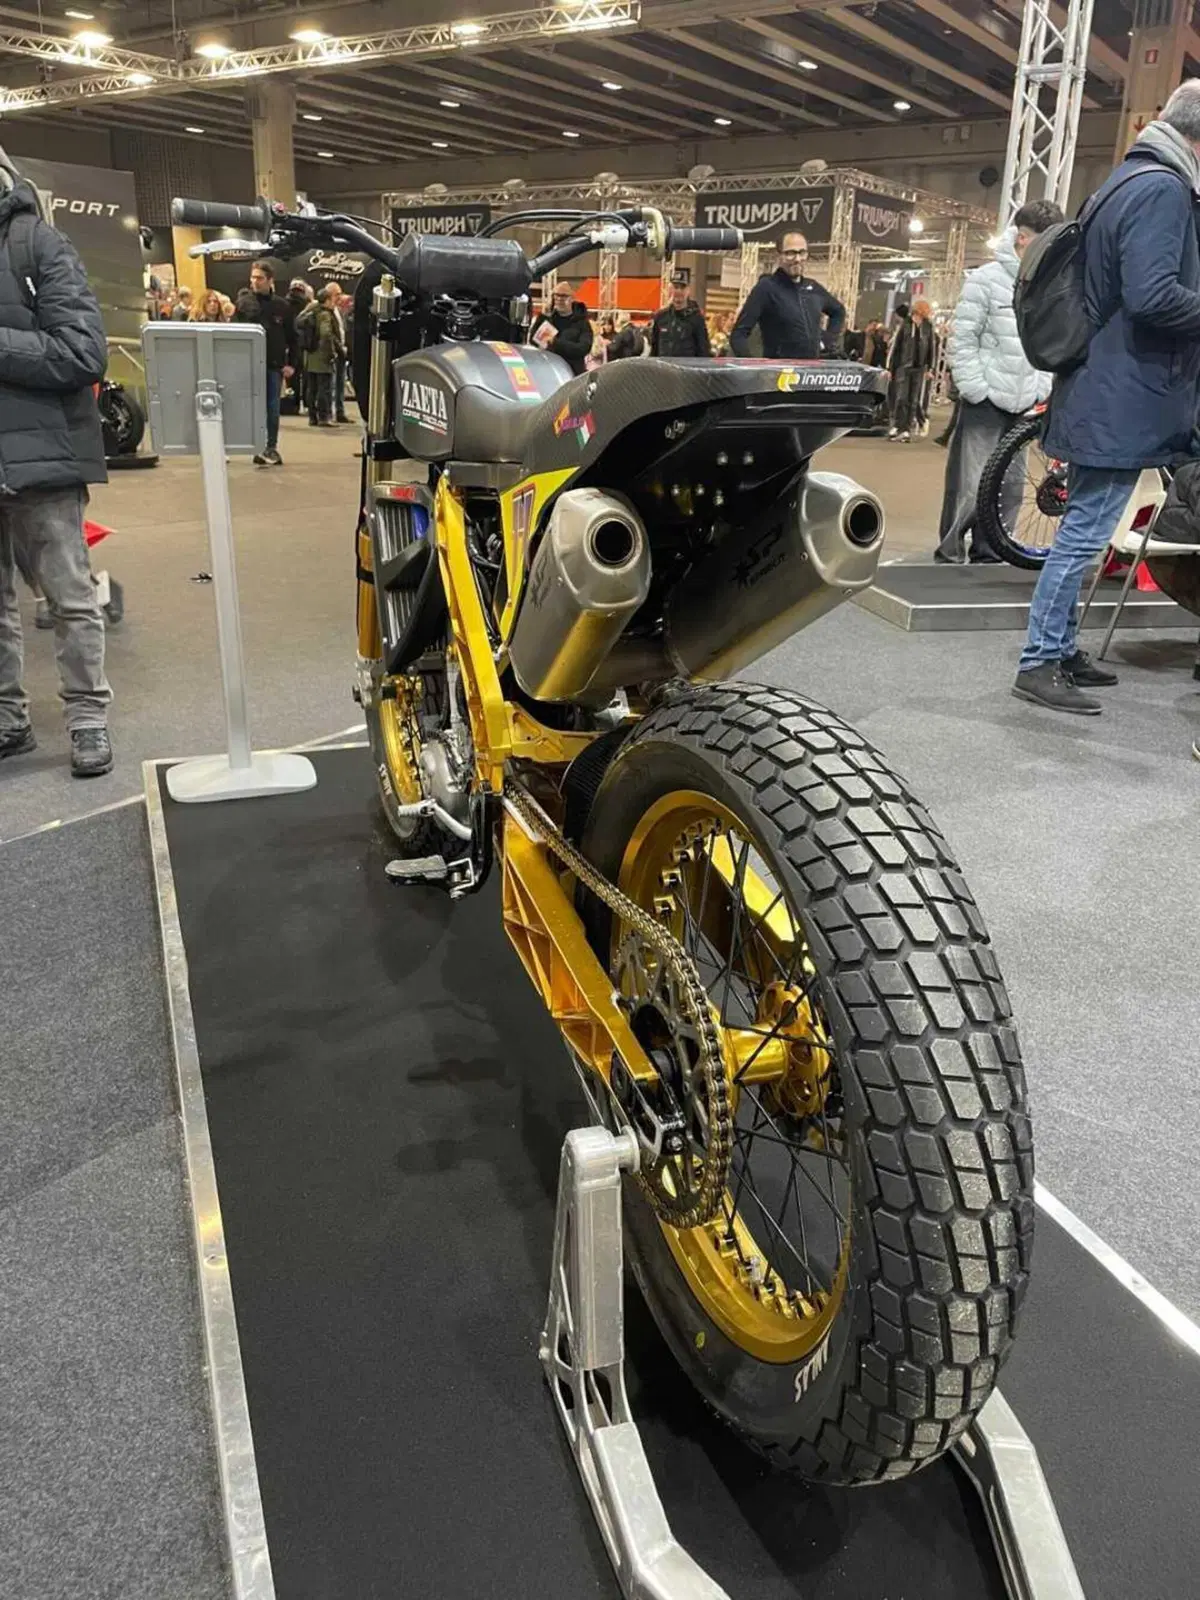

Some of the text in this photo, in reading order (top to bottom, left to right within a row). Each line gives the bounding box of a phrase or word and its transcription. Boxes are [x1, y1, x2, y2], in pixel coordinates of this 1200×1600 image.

[52, 198, 120, 217] PORT
[704, 202, 799, 233] TRIUMPH
[858, 203, 900, 236] TRIUMPH
[398, 216, 466, 236] TRIUMPH
[801, 372, 862, 385] inmotion
[400, 379, 448, 420] ZAETA
